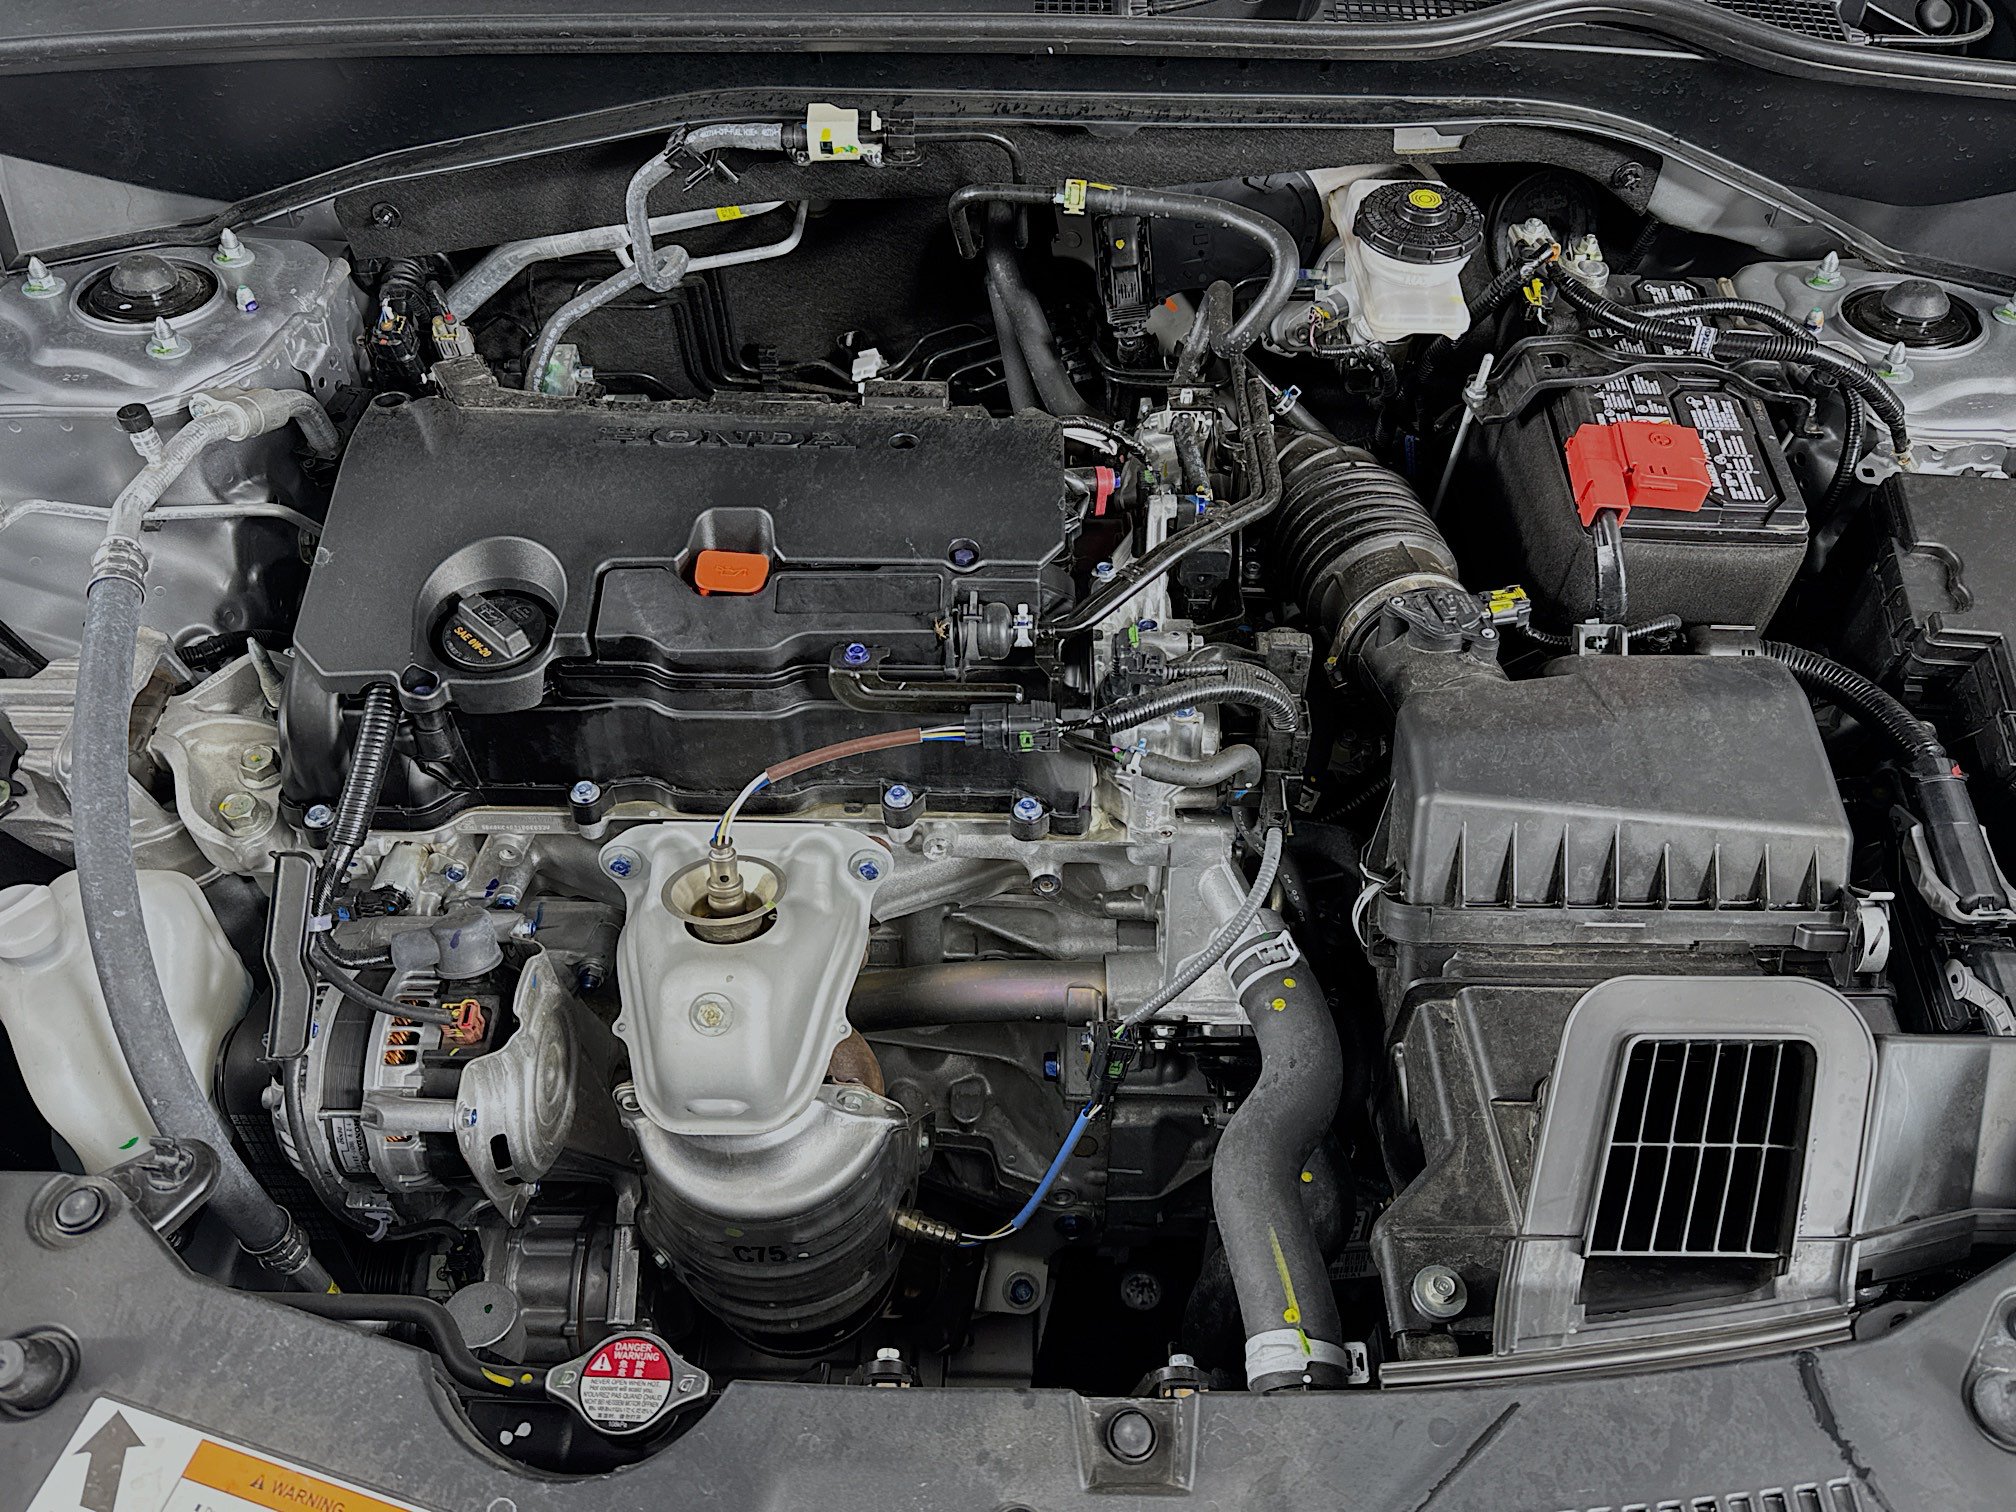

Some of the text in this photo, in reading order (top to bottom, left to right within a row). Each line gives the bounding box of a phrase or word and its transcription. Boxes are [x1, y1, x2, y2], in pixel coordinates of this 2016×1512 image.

[454, 626, 473, 642] SAE
[468, 638, 493, 658] 0W-20
[732, 1245, 788, 1263] C75
[615, 1342, 653, 1352] DANGER
[272, 1480, 345, 1512] WARNING
